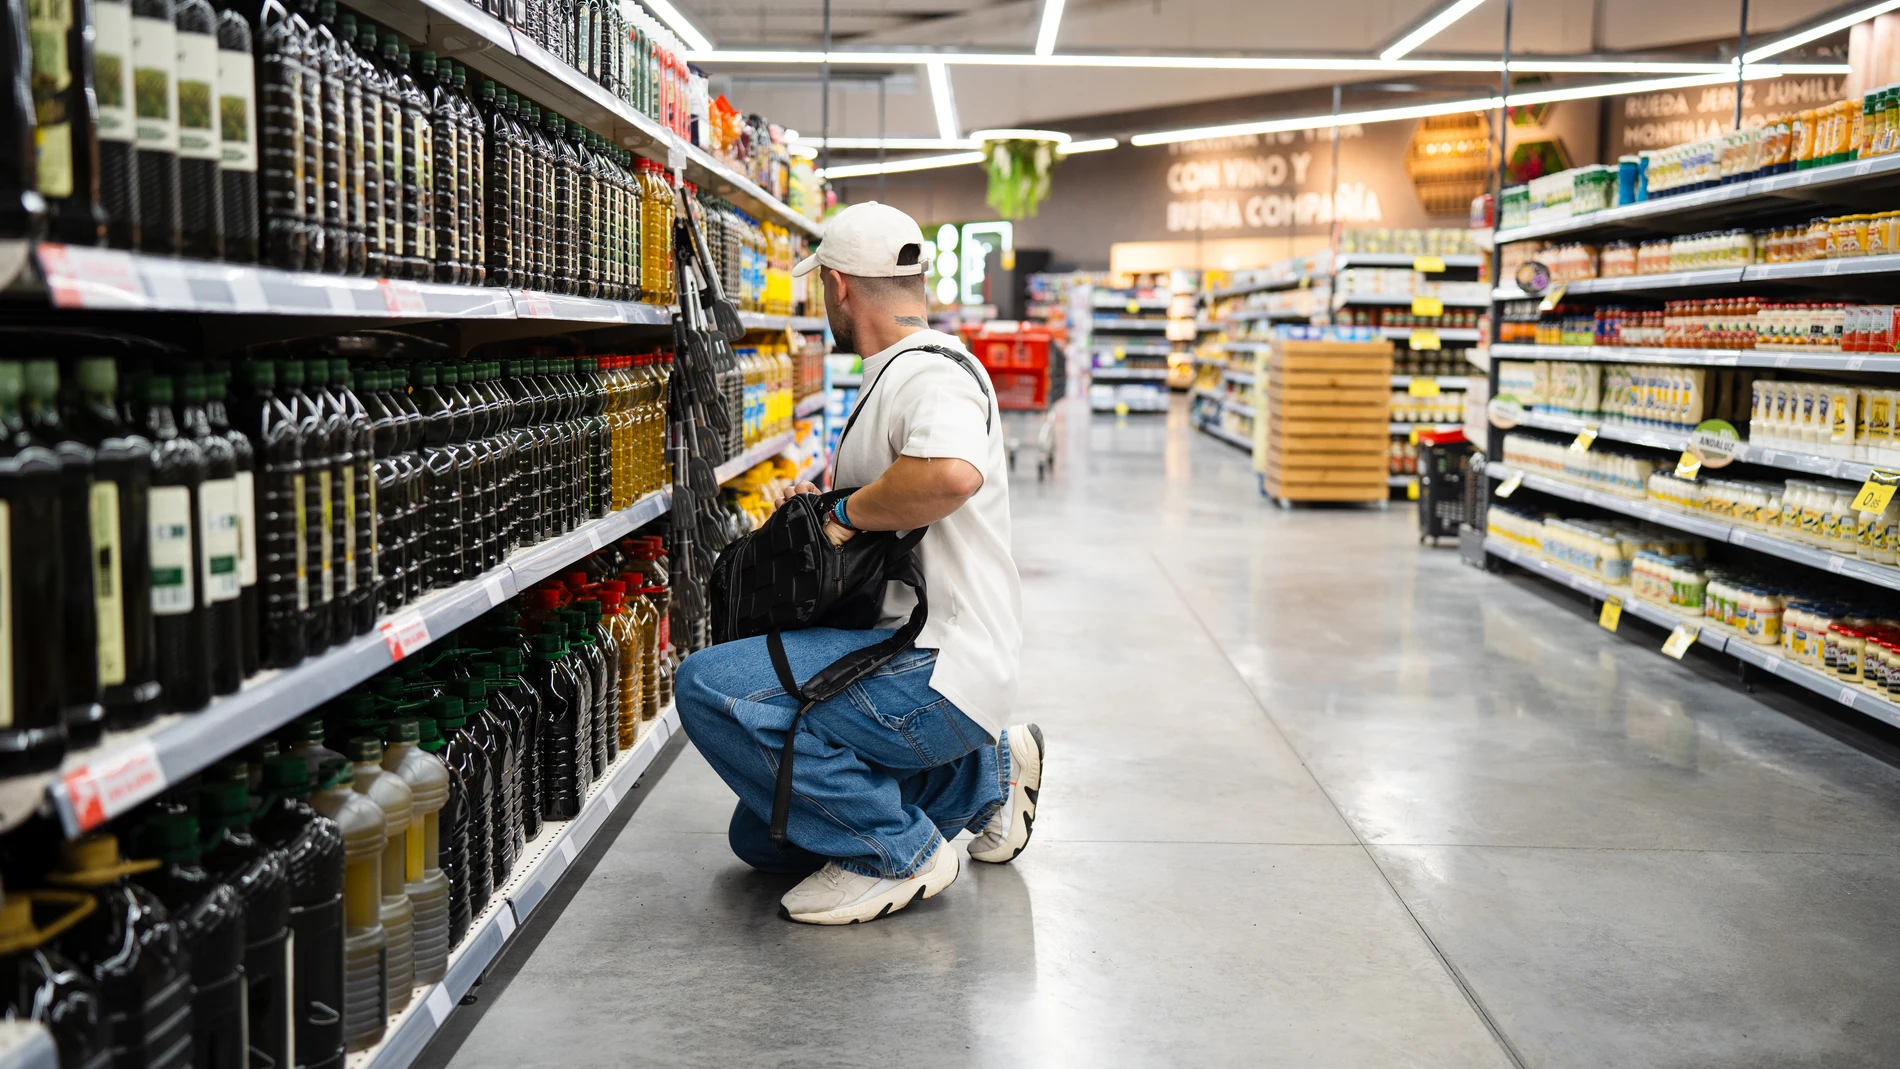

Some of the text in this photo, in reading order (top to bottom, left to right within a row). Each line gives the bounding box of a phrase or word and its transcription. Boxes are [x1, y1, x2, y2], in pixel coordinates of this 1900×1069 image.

[1625, 92, 1690, 119] RUEDA
[1167, 151, 1312, 194] CON VINO Y
[1166, 198, 1242, 231] BUENA
